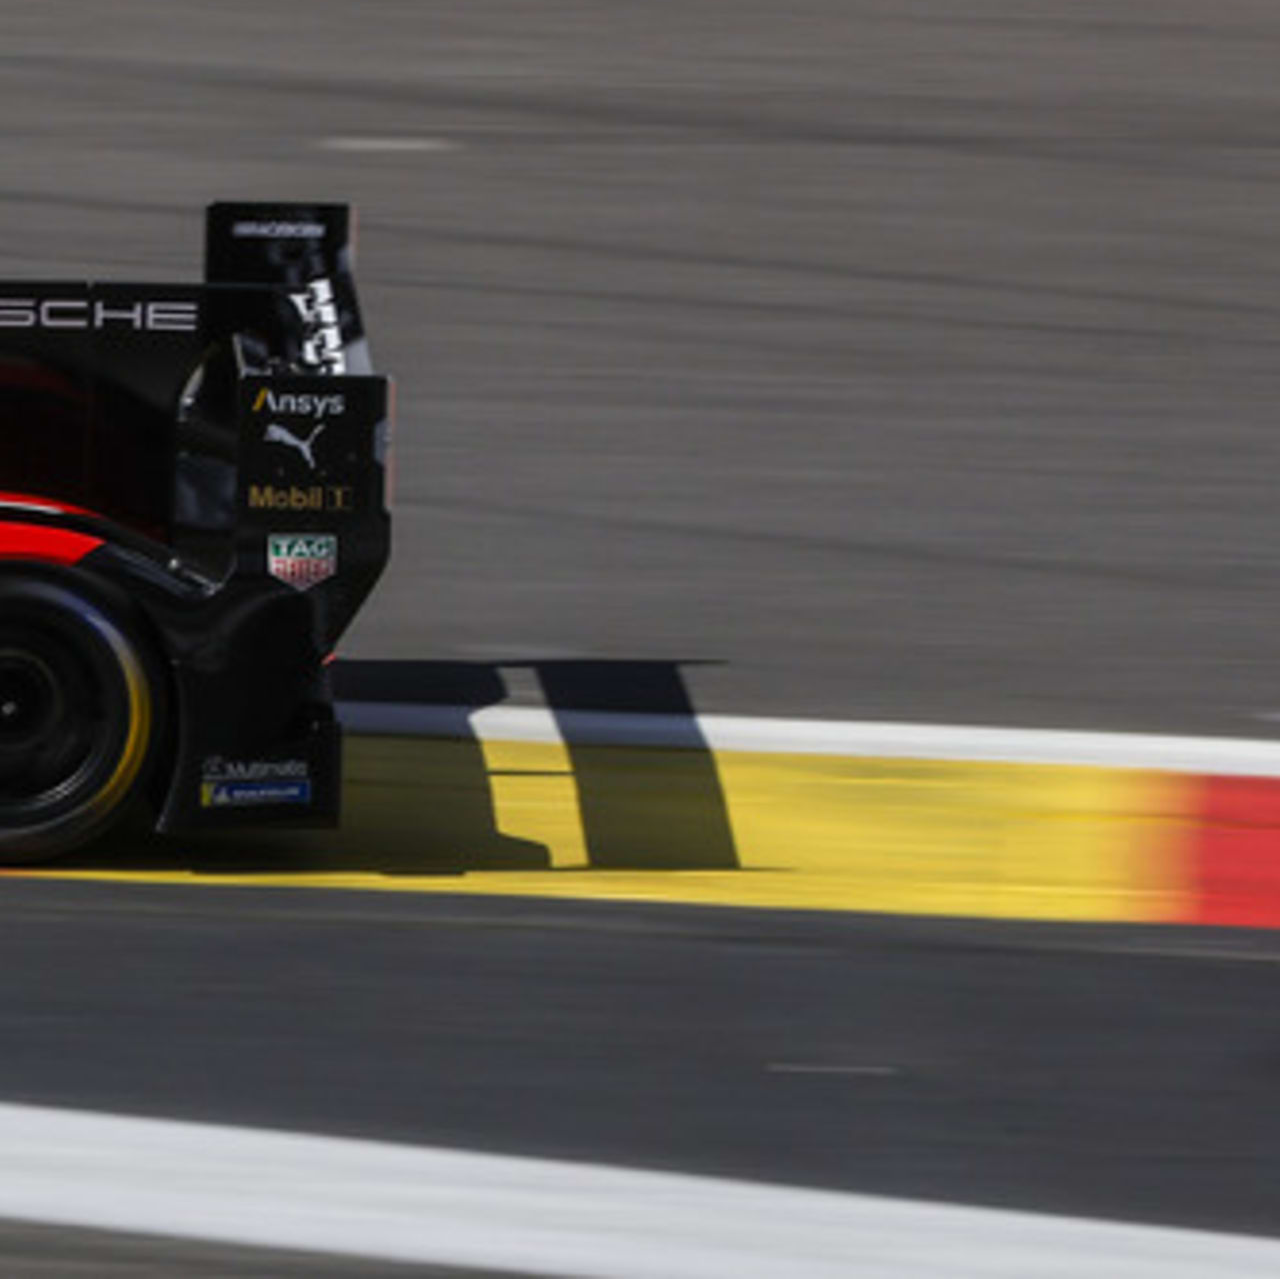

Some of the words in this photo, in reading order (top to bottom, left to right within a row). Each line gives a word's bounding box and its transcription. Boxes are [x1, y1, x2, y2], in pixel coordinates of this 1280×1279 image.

[252, 388, 345, 419] Ansys
[248, 486, 322, 510] Mobil
[274, 538, 329, 558] TAG
